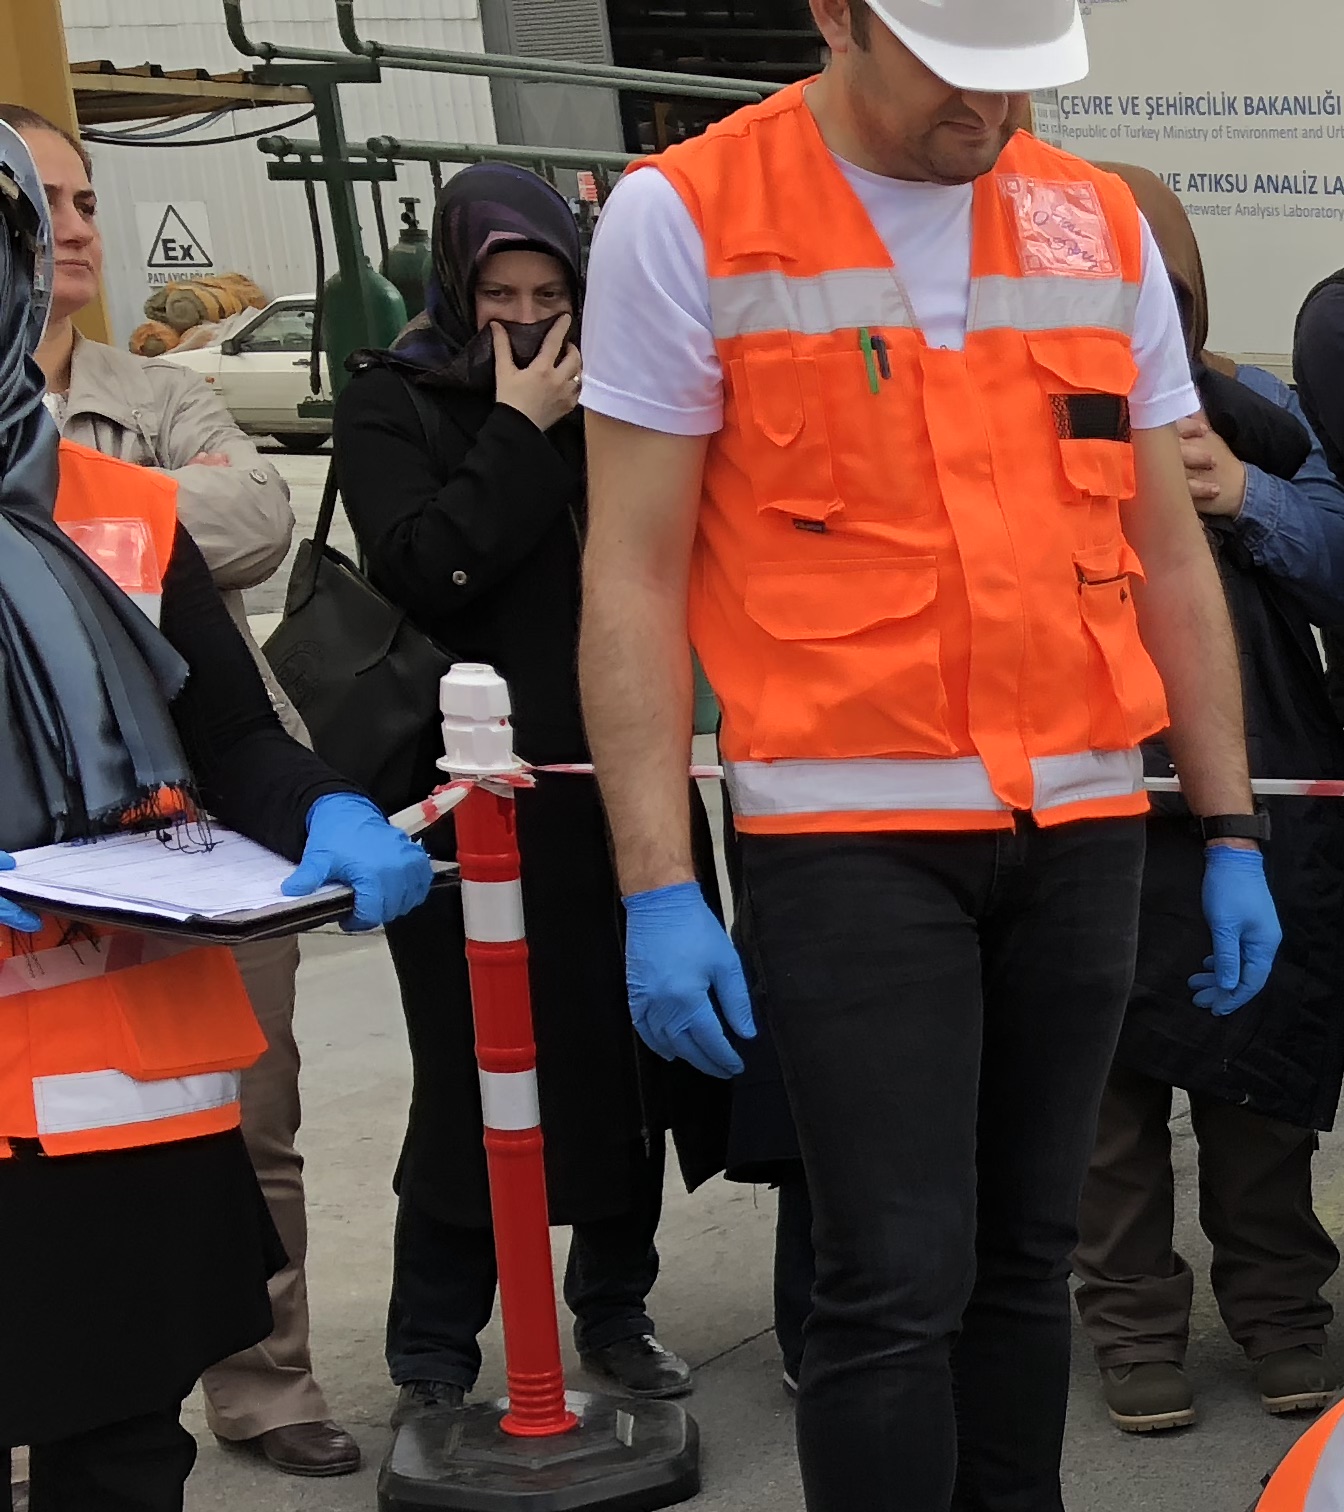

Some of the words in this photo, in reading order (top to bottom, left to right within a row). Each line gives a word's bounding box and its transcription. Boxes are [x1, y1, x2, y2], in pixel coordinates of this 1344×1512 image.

[1060, 95, 1113, 119] ÇEVRE
[1117, 95, 1140, 115] VE
[1145, 91, 1238, 120] ŞEHİRCİLİK
[1243, 90, 1342, 116] BAKANLIĞI
[1061, 125, 1107, 139] Republic
[1109, 124, 1122, 138] of
[1123, 125, 1160, 141] Turkey
[1163, 126, 1208, 141] Ministry
[1211, 125, 1223, 139] of
[1226, 126, 1298, 140] Environment
[1301, 126, 1322, 139] and
[1187, 173, 1248, 193] ATIKSU
[1253, 170, 1318, 195] ANALİZ
[1235, 203, 1280, 219] Analysis
[1283, 204, 1344, 221] Laboratory
[161, 238, 195, 261] Ex
